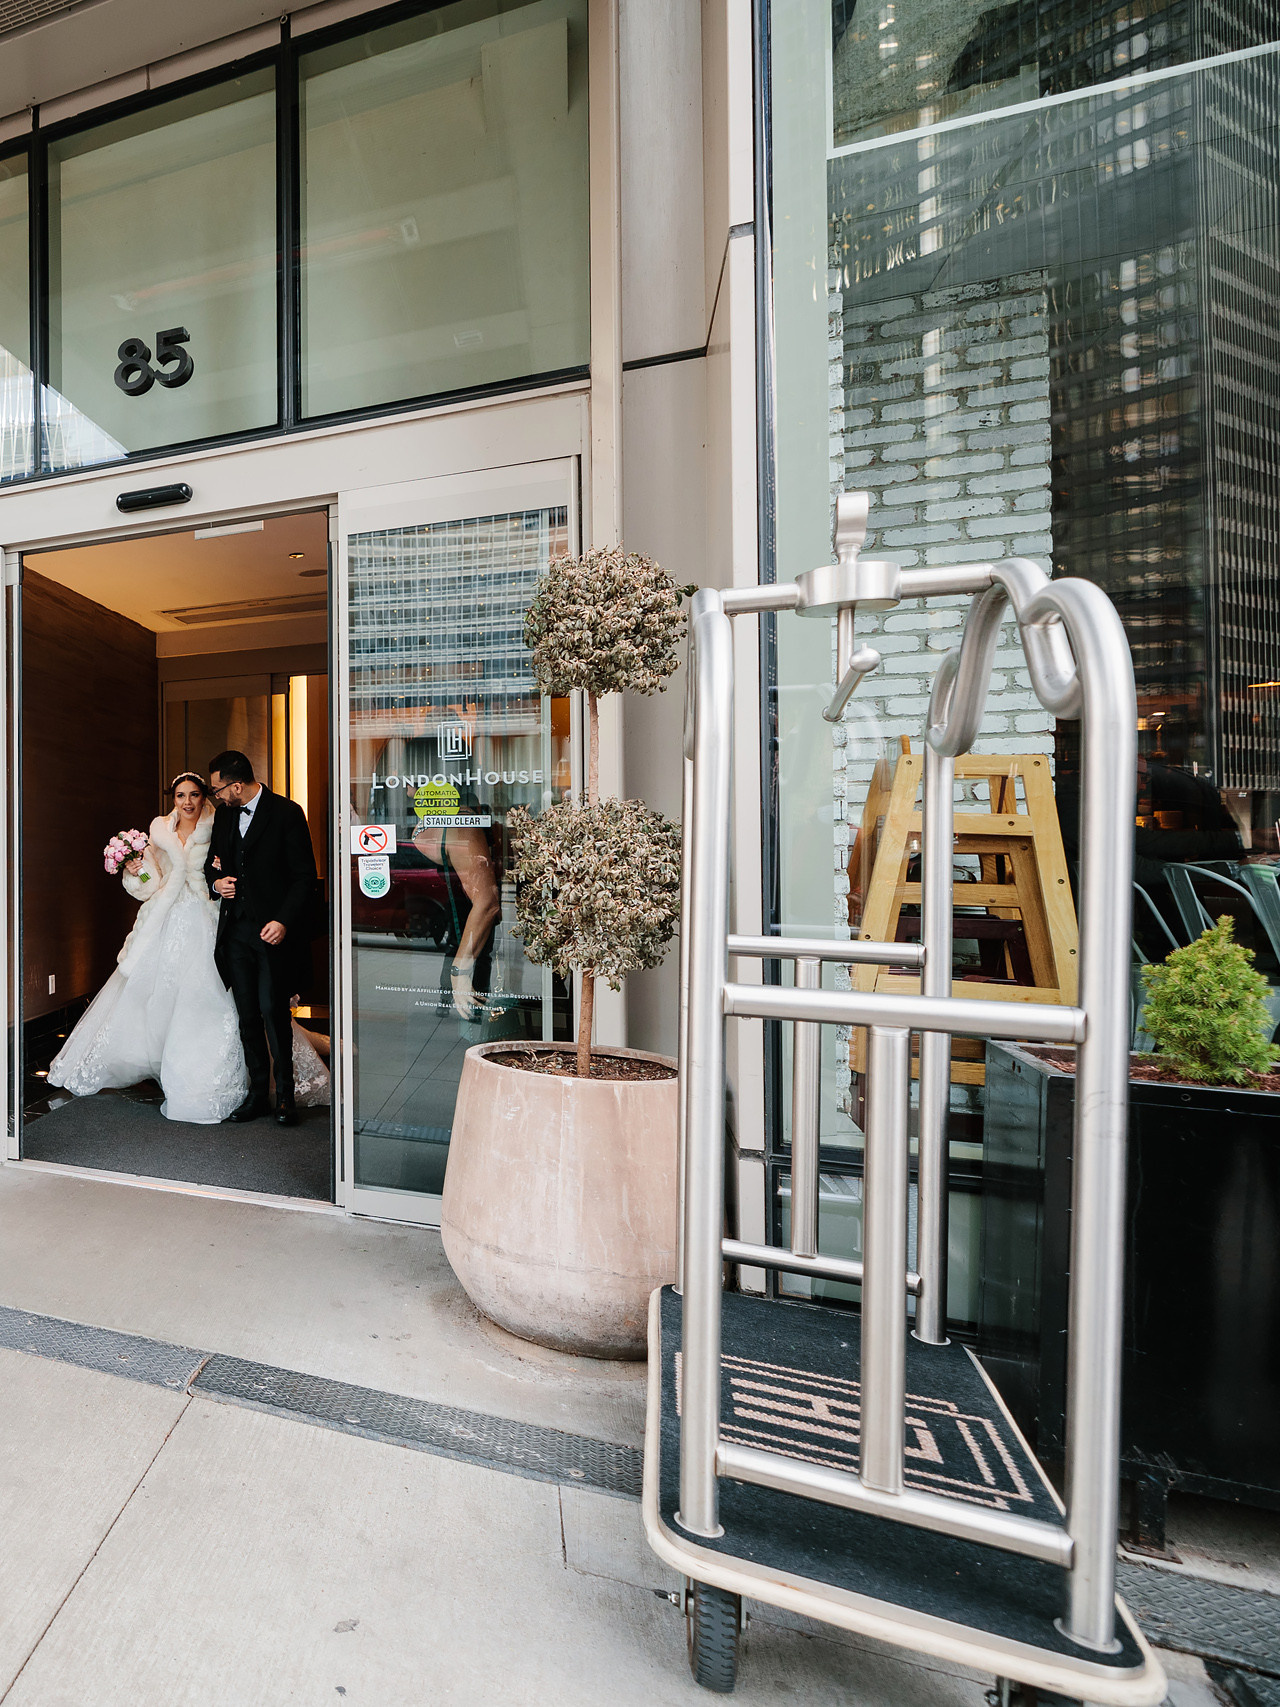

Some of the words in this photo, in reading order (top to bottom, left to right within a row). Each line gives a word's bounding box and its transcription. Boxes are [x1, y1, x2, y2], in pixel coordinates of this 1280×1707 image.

[114, 326, 194, 396] 85
[372, 769, 544, 790] LONDONHOUSE
[414, 799, 459, 807] CAUTION
[426, 817, 452, 825] STAND
[454, 817, 481, 825] CLEAR
